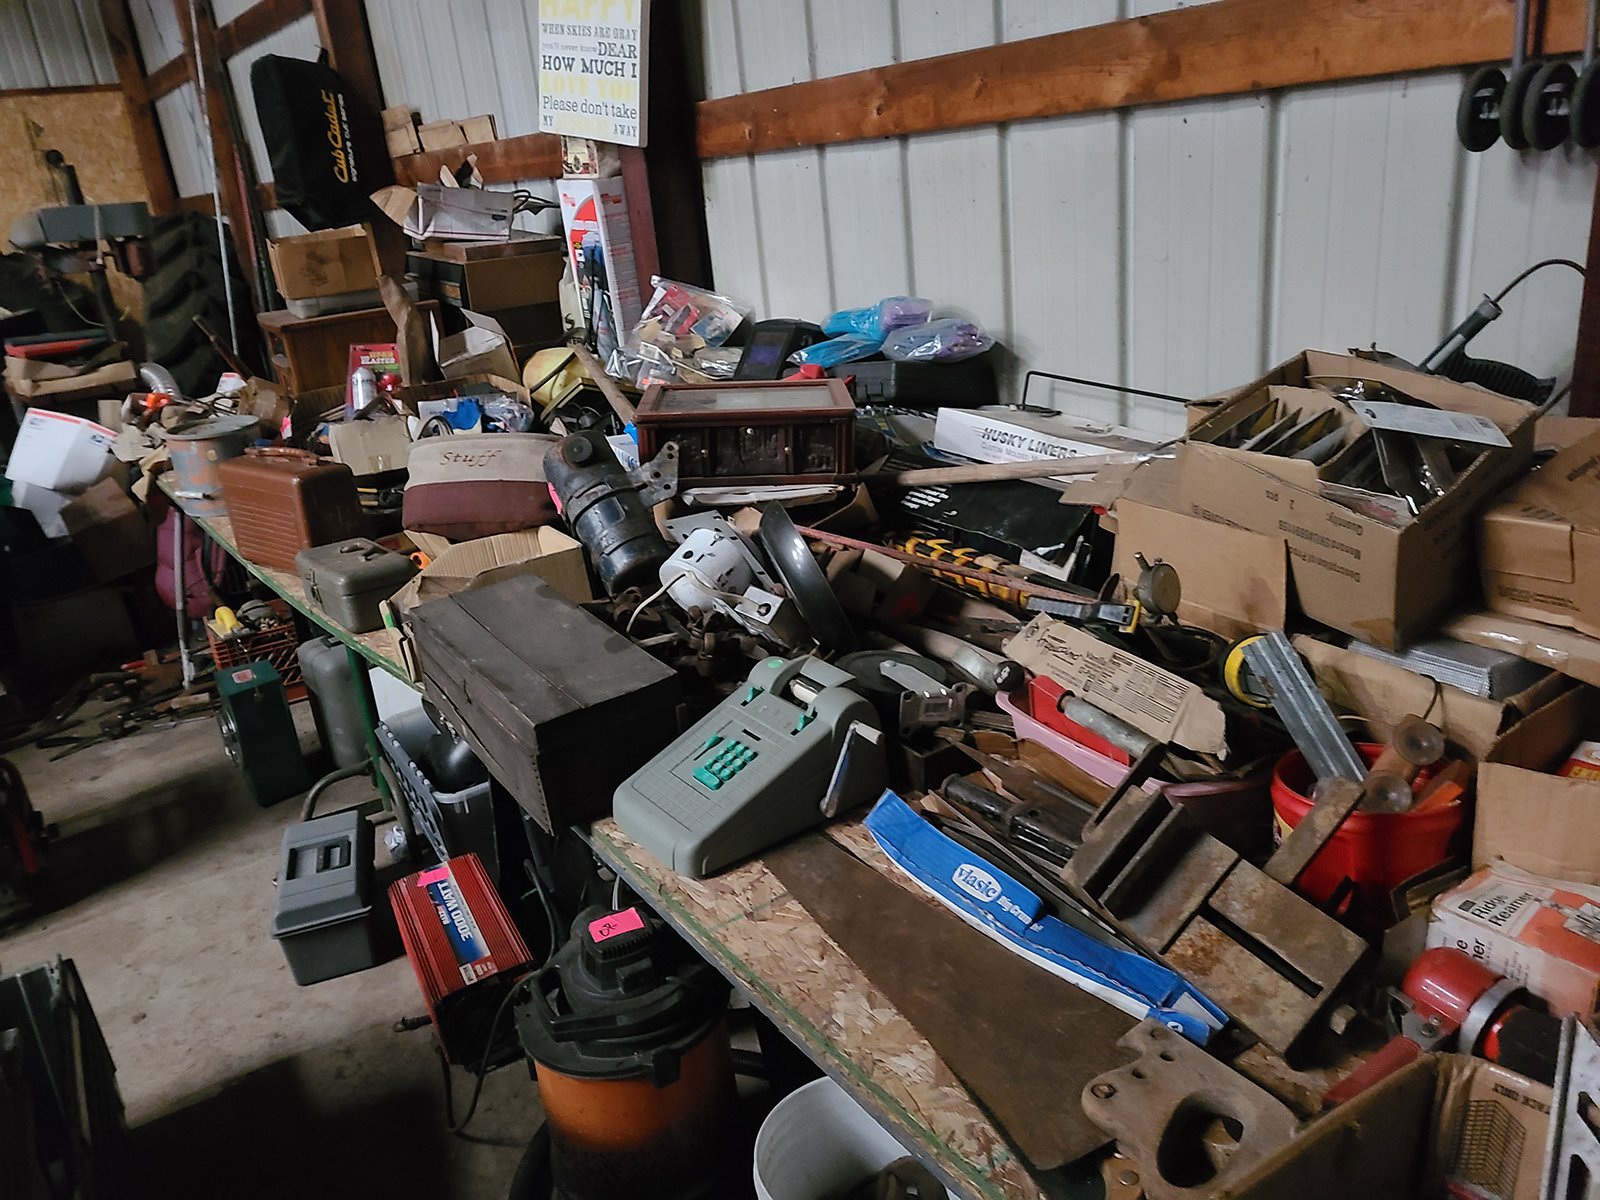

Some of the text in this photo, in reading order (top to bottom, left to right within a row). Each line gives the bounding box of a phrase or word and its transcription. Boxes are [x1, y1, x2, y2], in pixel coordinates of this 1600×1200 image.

[541, 23, 638, 40] WHEN SKIES ARE GRAY
[598, 42, 638, 59] DEAR
[542, 55, 637, 78] HOW MUCH I
[542, 96, 637, 119] Please don't take
[320, 89, 349, 184] Cub Cadet
[614, 124, 638, 138] AWAY
[981, 427, 1078, 460] HUSKY LINERS
[440, 450, 502, 467] Stuff
[958, 868, 998, 898] vlasic
[438, 882, 459, 911] WATT
[450, 909, 474, 942] 3000
